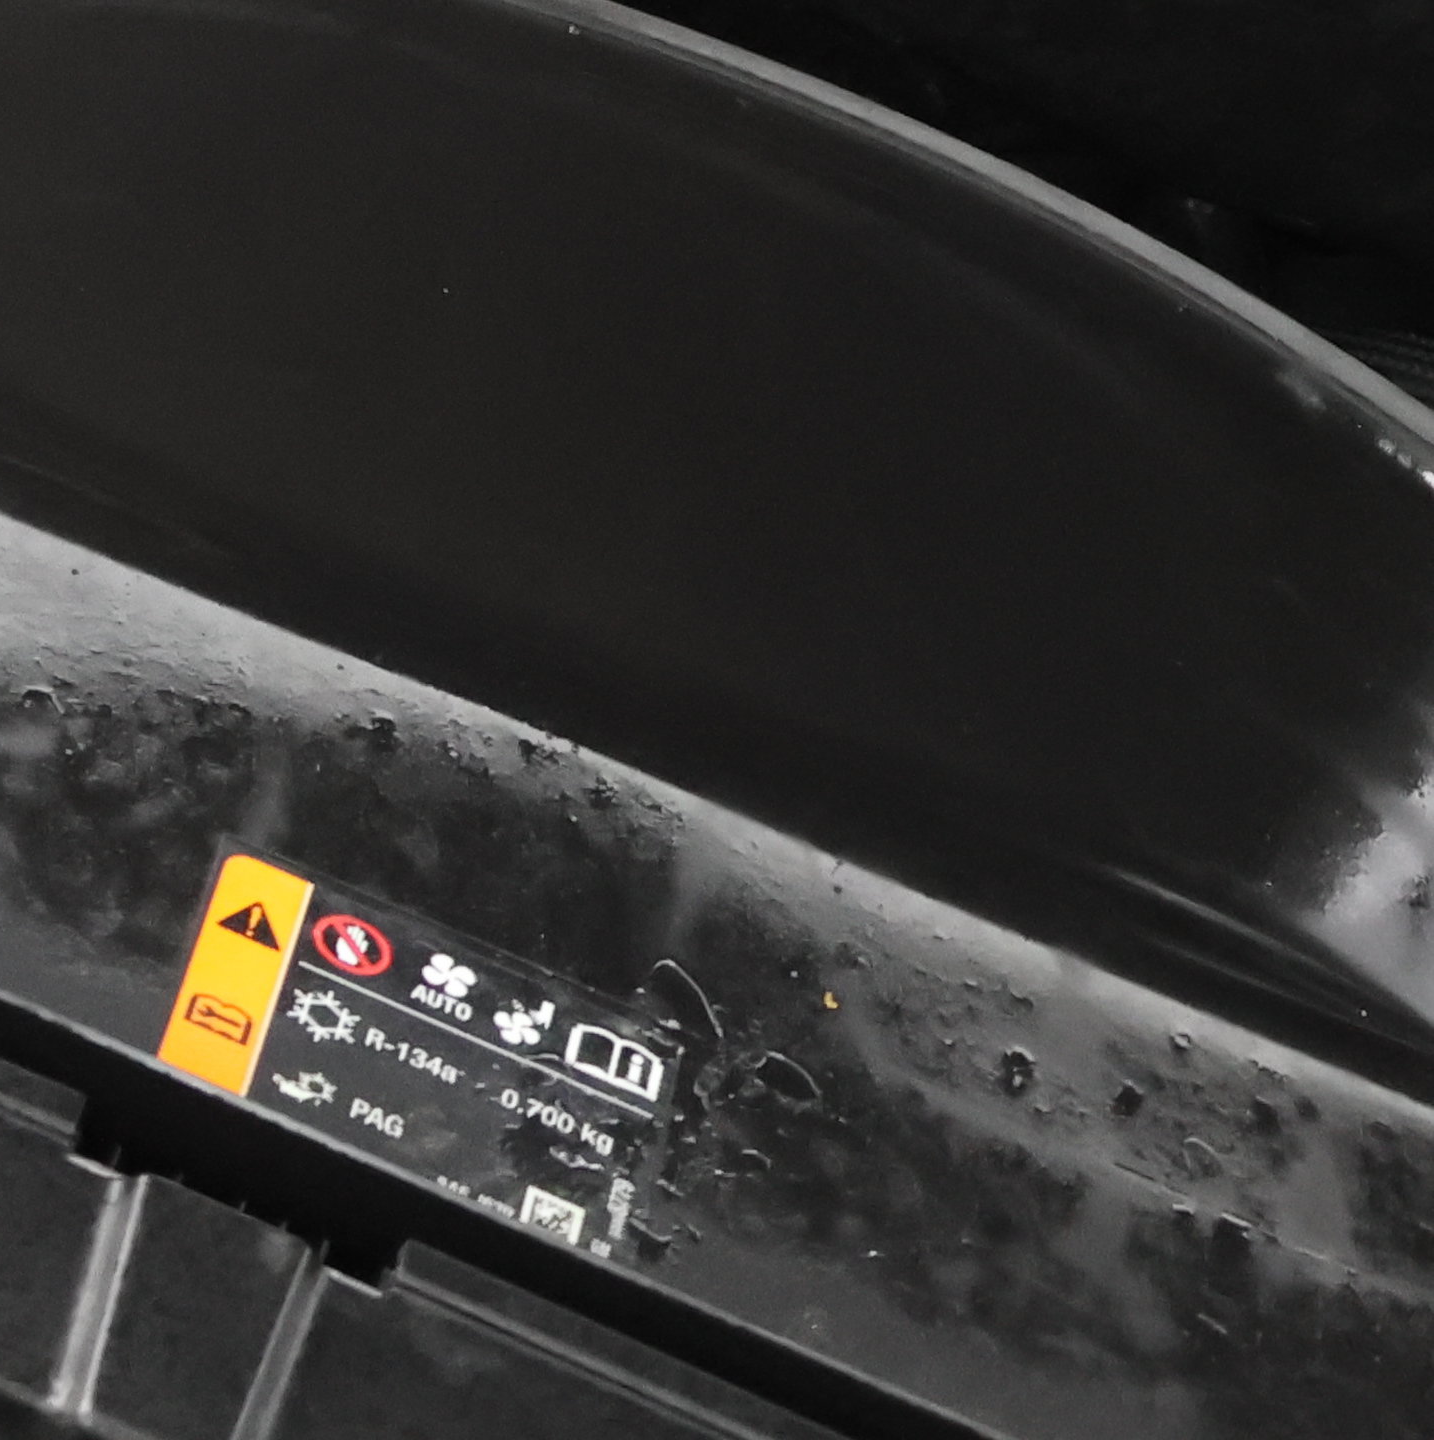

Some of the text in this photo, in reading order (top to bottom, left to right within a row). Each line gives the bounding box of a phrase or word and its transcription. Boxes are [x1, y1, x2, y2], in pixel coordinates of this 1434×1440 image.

[410, 983, 473, 1023] AUTO
[364, 1027, 458, 1085] R-134a
[349, 1097, 405, 1140] PAG
[500, 1088, 615, 1157] 0.700 kg
